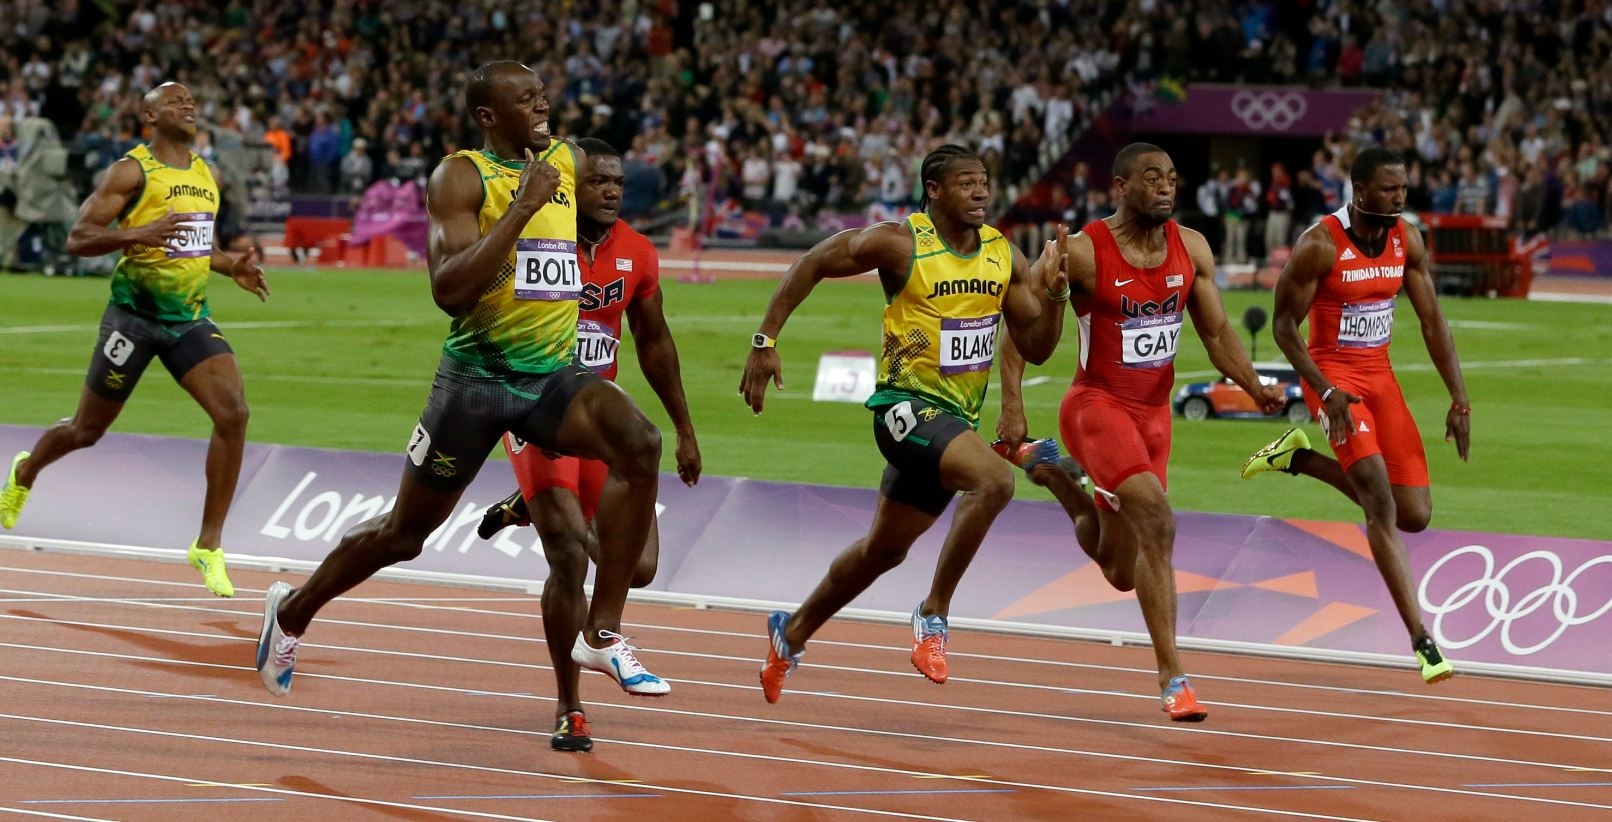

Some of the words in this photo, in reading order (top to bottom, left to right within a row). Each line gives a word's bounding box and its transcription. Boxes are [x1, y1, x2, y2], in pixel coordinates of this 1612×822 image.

[165, 184, 215, 205] JAMAICA
[537, 241, 556, 250] London
[526, 258, 576, 285] BOLT
[1342, 267, 1375, 282] TRINIDAD
[1380, 265, 1404, 278] TOBAGO
[578, 276, 625, 311] SA
[927, 278, 1004, 299] JAMAICA
[1121, 290, 1180, 319] USA
[960, 320, 982, 328] London
[982, 318, 993, 326] 2012
[1140, 318, 1163, 327] London
[109, 338, 126, 359] 3
[577, 337, 616, 361] TLIN
[951, 332, 994, 361] BLAKE
[1134, 328, 1180, 357] GAY
[893, 406, 908, 435] 5
[409, 428, 425, 453] 7
